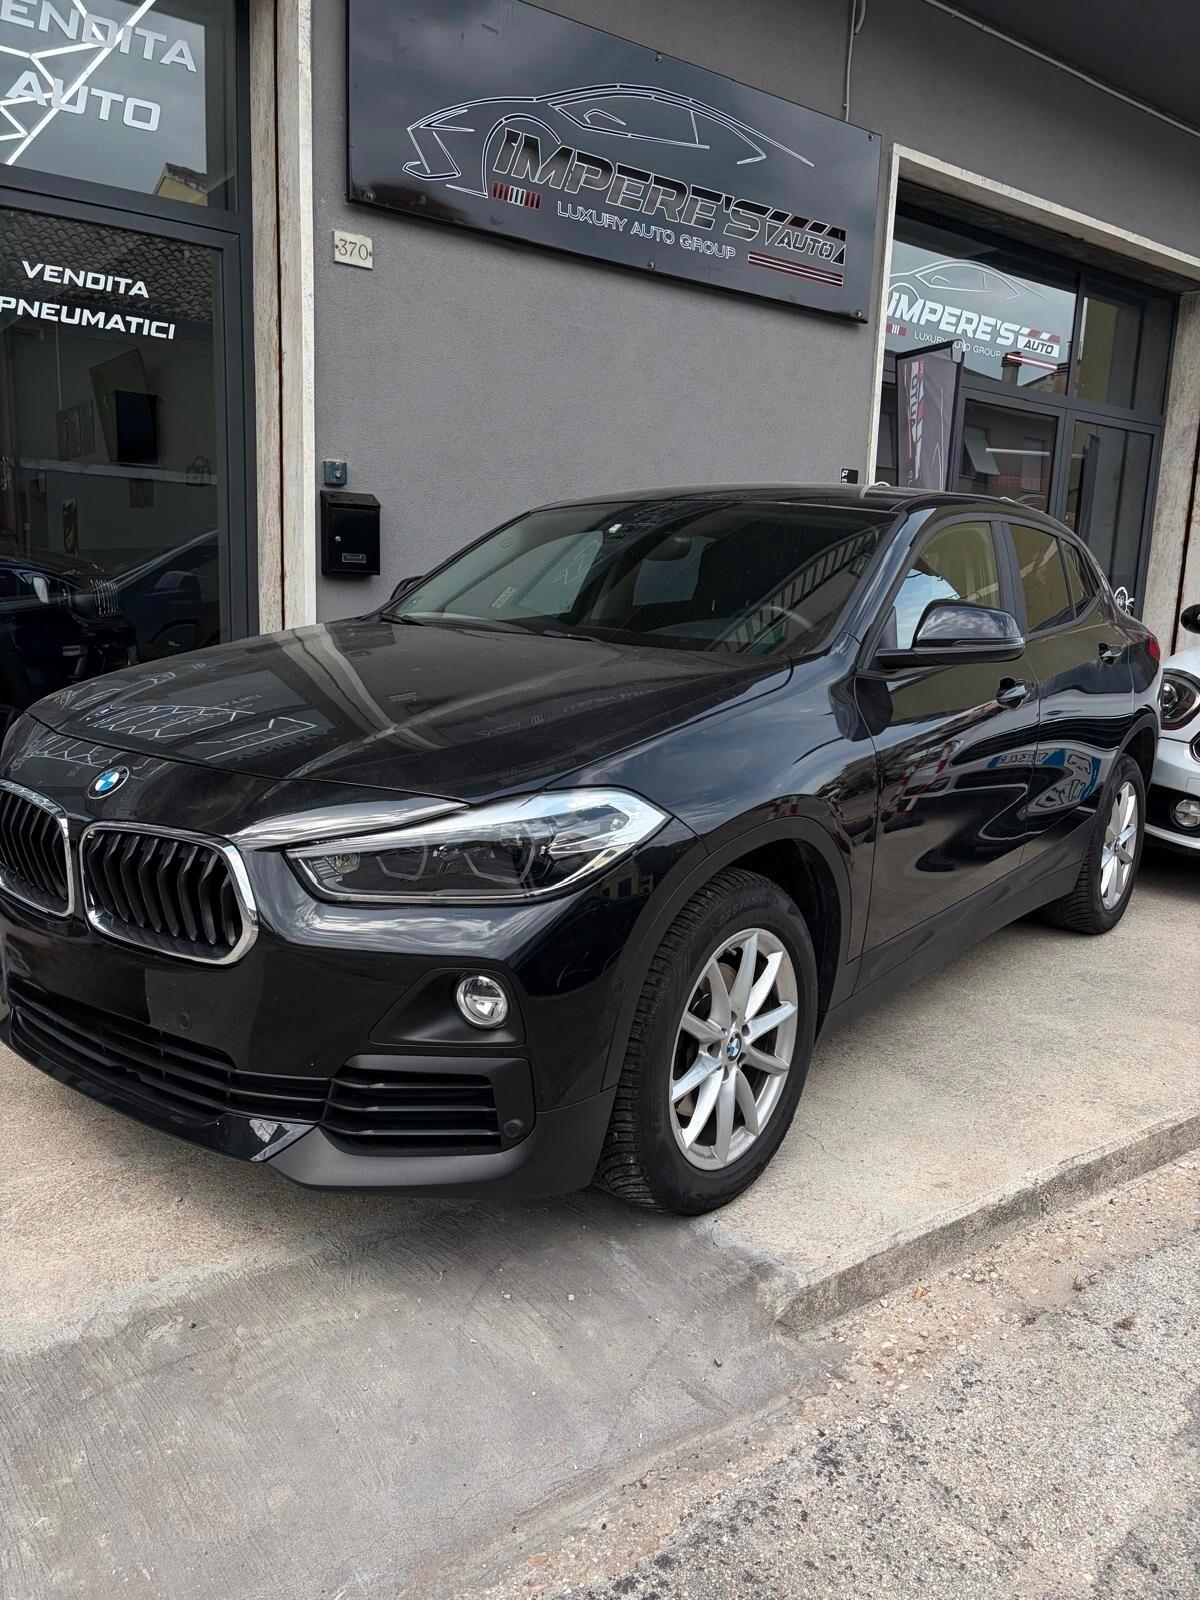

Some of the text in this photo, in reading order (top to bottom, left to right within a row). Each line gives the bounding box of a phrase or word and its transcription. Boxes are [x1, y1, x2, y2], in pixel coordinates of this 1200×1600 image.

[5, 70, 161, 132] AUTO
[557, 201, 736, 259] LUXURY AUTO GROUP
[775, 229, 836, 260] AUTO
[338, 238, 368, 260] 370
[22, 260, 149, 299] VENDITA
[0, 295, 176, 340] PNEUMATICI
[972, 344, 1001, 358] GROUP
[1023, 340, 1054, 355] AUTO
